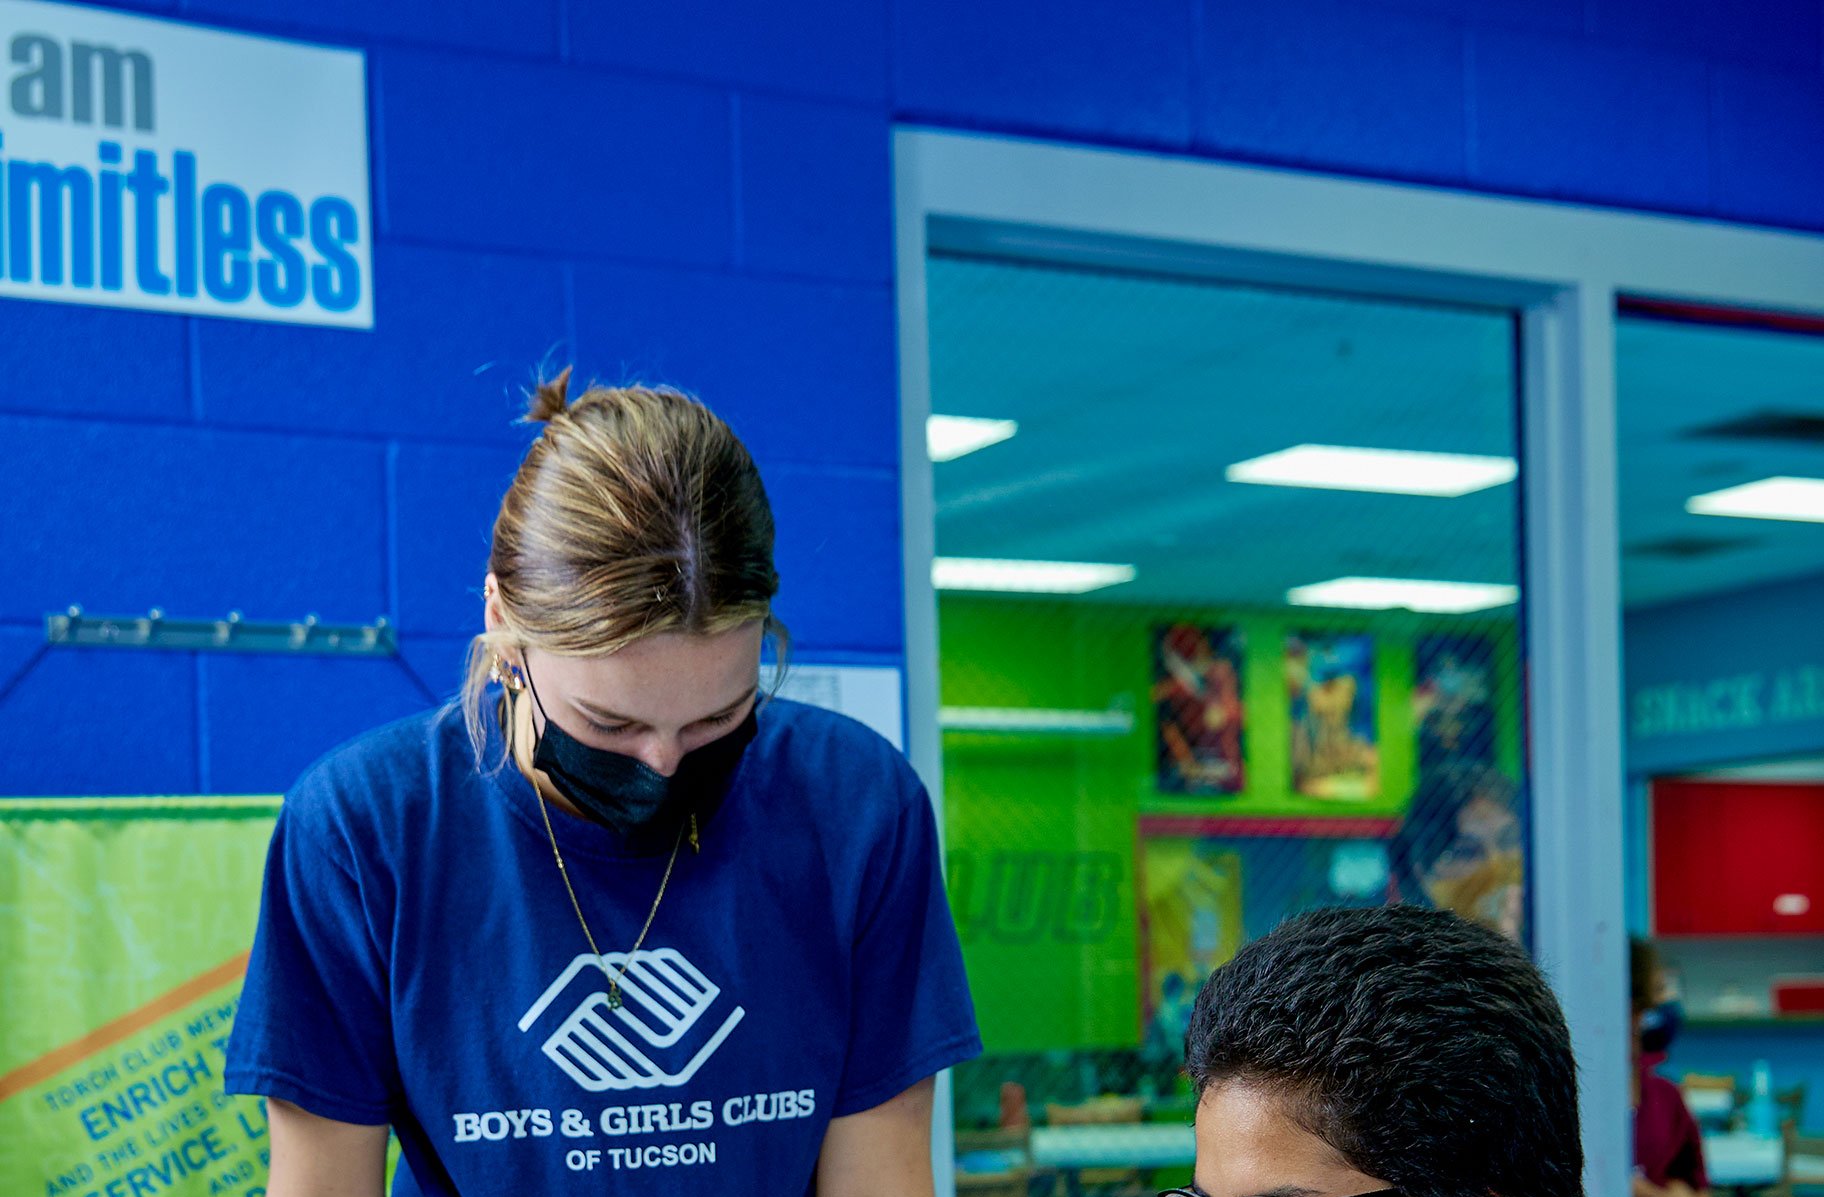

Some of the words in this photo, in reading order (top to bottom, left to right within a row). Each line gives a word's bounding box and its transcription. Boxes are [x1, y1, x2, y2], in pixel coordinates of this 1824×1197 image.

[9, 31, 154, 132] am
[0, 130, 362, 312] mitless
[44, 1063, 120, 1112] TORCH
[121, 1031, 182, 1074] CLUB
[185, 998, 240, 1038] MEM
[79, 1051, 213, 1141] ENRICH
[453, 1108, 553, 1142] BOYS
[560, 1108, 594, 1138] &
[599, 1100, 714, 1136] GIRLS
[722, 1089, 815, 1126] CLUBS
[97, 1136, 142, 1170] THE
[144, 1102, 209, 1148] LIVES
[565, 1150, 601, 1171] OF
[608, 1142, 716, 1170] TUCSON
[209, 1160, 255, 1197] AND
